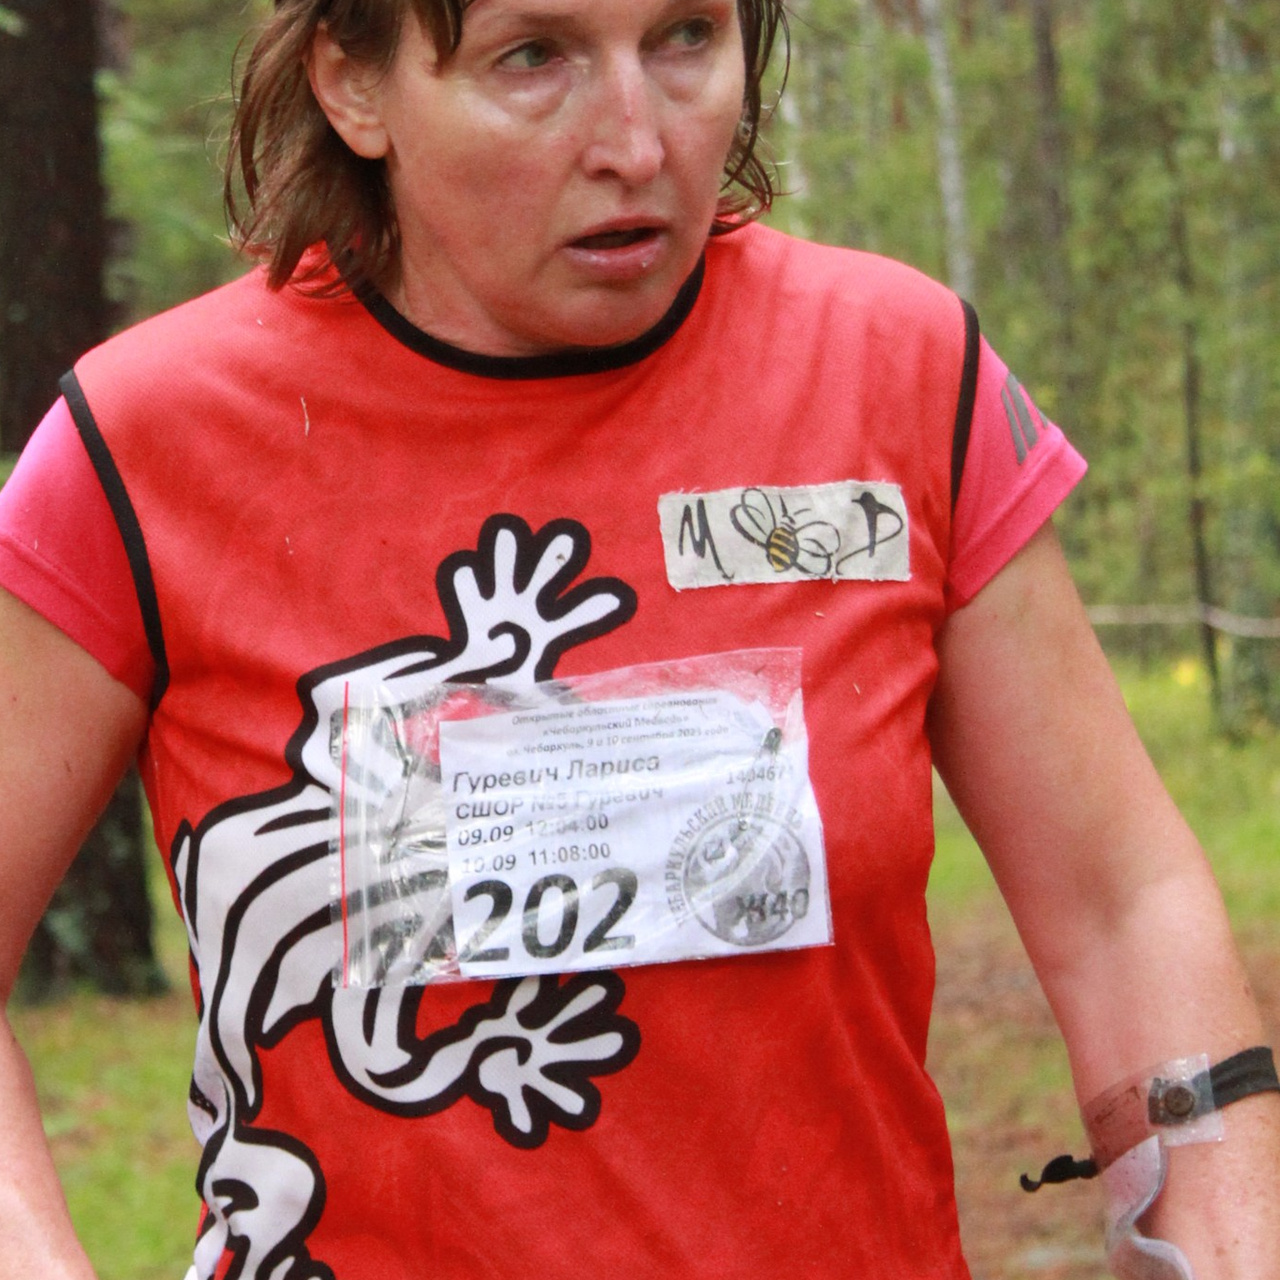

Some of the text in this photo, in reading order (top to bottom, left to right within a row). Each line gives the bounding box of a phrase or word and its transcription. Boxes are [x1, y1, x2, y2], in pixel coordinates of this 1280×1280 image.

[452, 755, 661, 795] Гуревич Лариса
[455, 798, 525, 821] СШОР
[457, 824, 515, 847] 09.09
[528, 842, 612, 867] 11:08:00
[458, 866, 640, 964] 202
